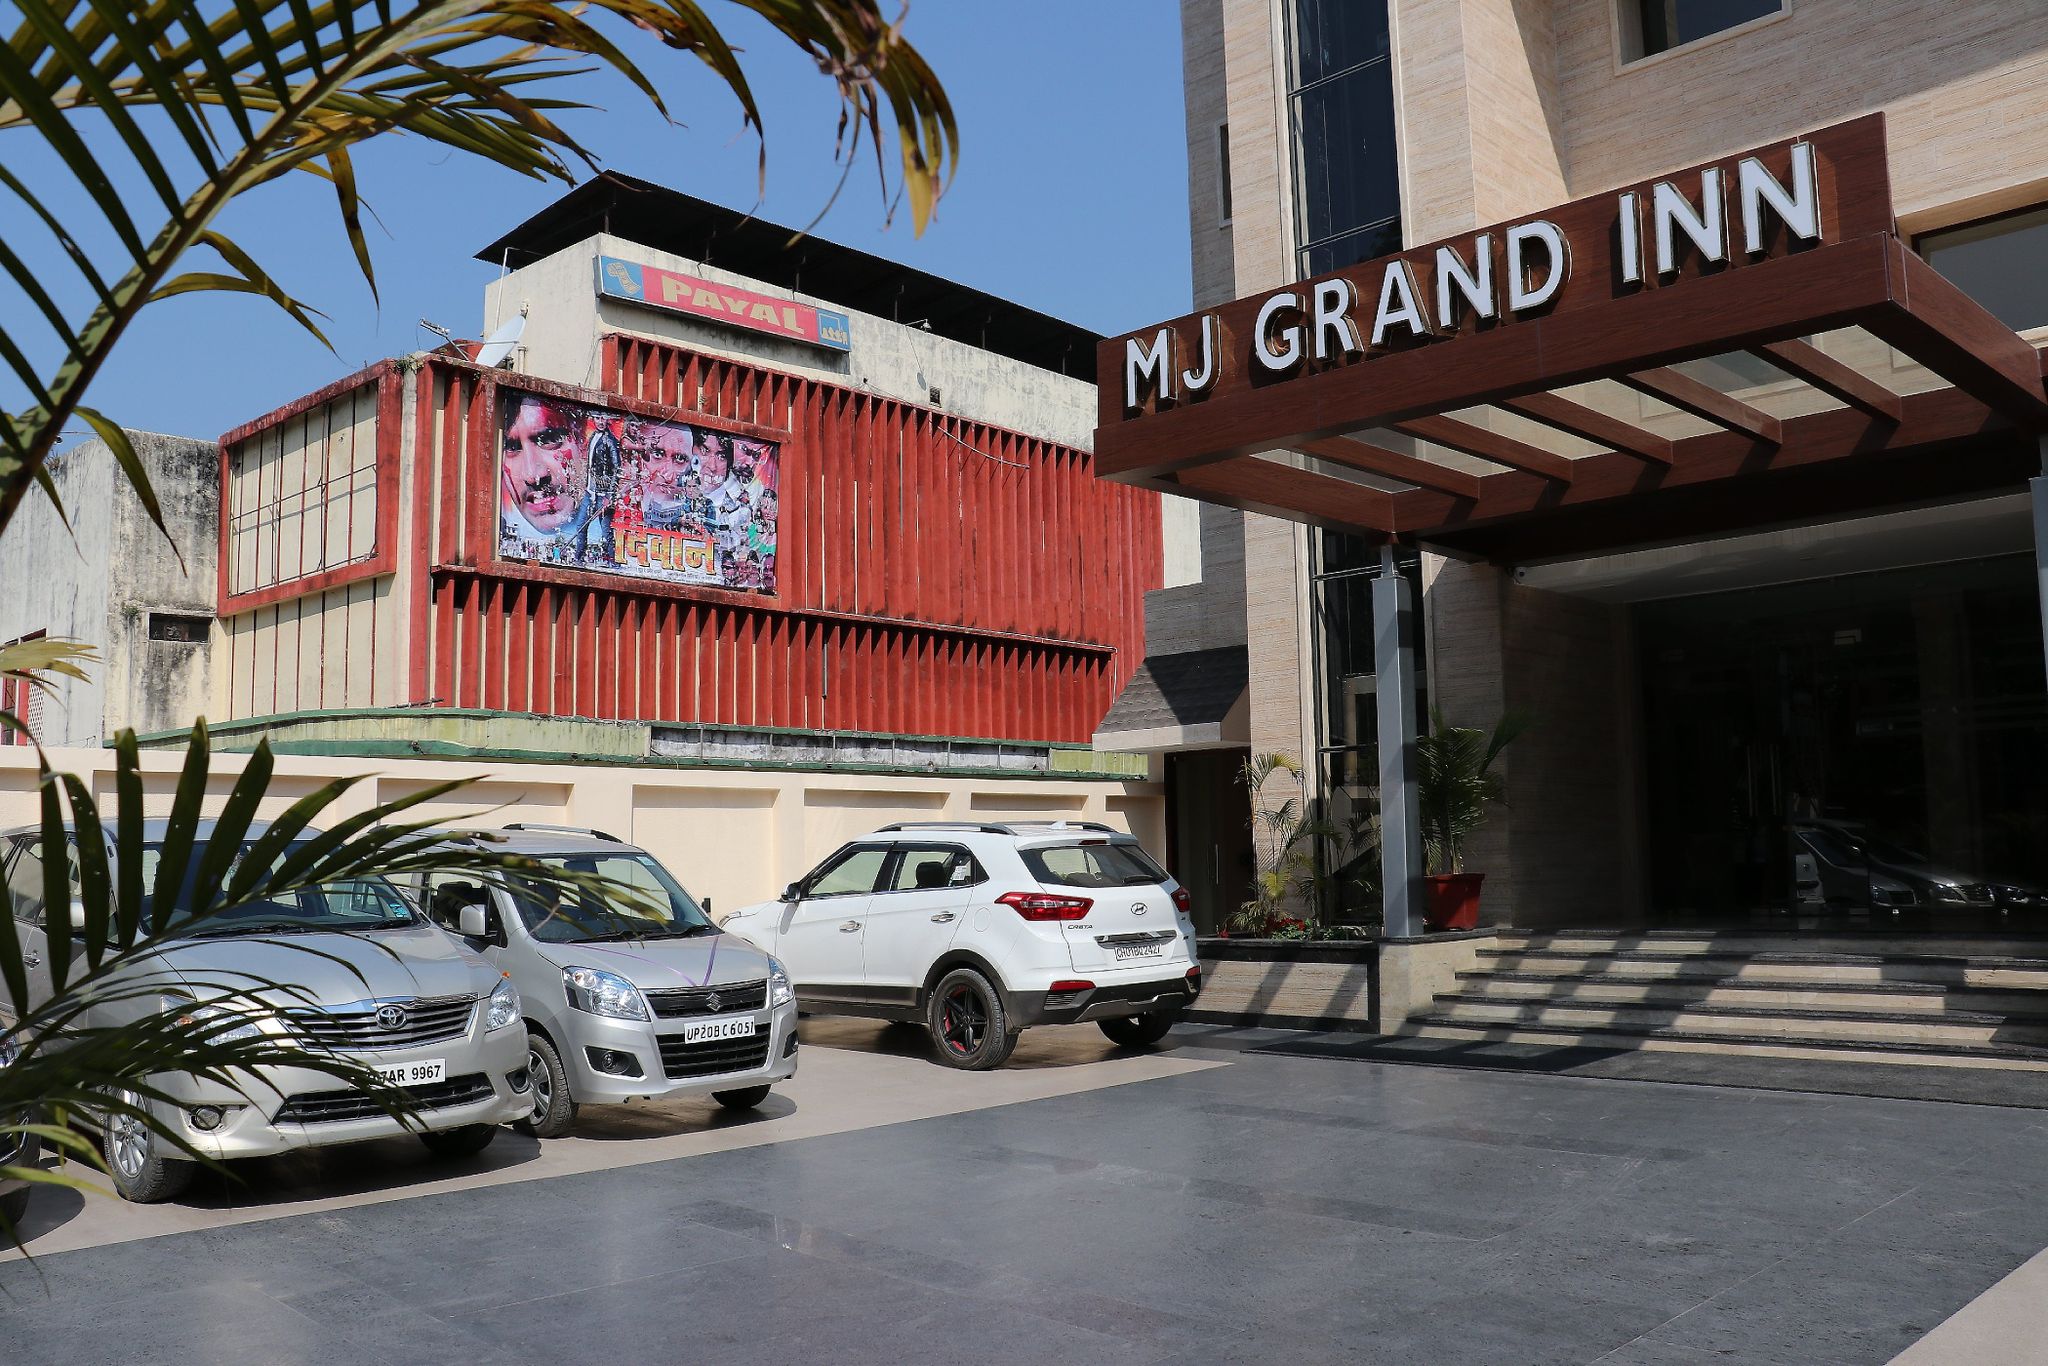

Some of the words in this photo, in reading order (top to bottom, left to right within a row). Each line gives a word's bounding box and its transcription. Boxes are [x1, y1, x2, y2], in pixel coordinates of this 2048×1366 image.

[661, 274, 805, 334] PAYAL
[1125, 314, 1218, 408] MJ
[1254, 220, 1570, 371] GRAND
[1620, 143, 1820, 283] INN
[411, 1065, 442, 1081] 9967
